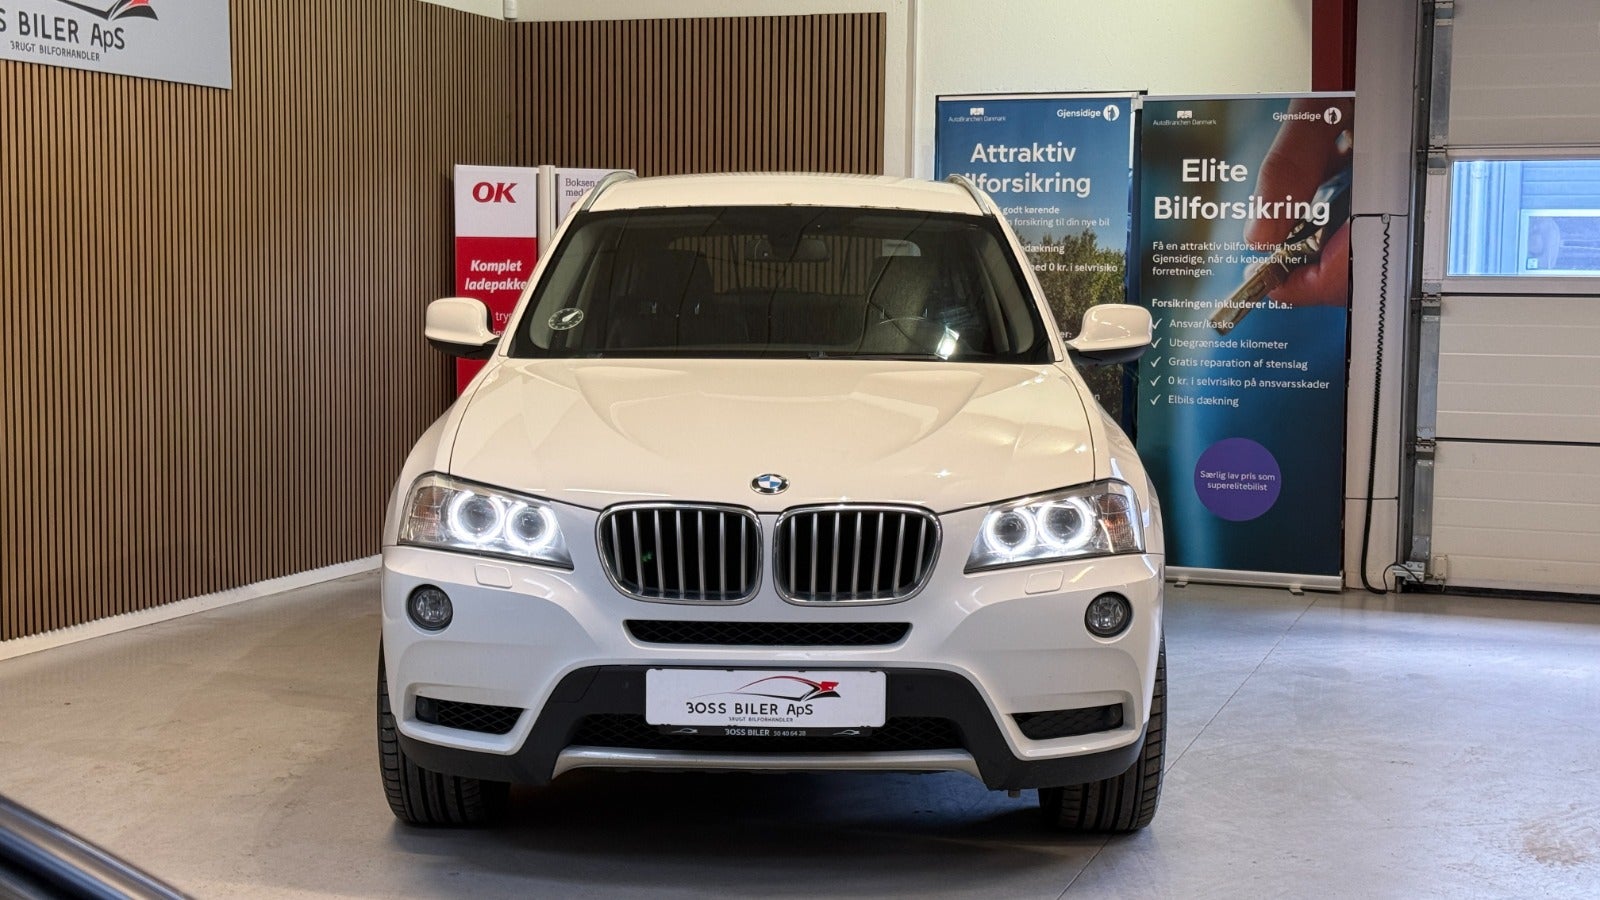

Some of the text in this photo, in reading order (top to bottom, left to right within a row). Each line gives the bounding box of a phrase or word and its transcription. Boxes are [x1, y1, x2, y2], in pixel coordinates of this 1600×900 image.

[18, 11, 79, 43] BILER
[91, 23, 125, 52] ApS
[39, 44, 100, 62] BILFORHANDLER
[1056, 108, 1101, 118] Gjensidige
[1272, 112, 1321, 122] Gjensidige
[970, 141, 1077, 163] Attraktiv
[1182, 157, 1248, 183] Elite
[565, 178, 595, 187] Boksen
[472, 181, 518, 204] OK
[565, 188, 584, 197] med
[1003, 205, 1022, 216] godt
[1024, 205, 1060, 215] kørende
[1154, 195, 1330, 226] Bilforsikring
[1014, 218, 1054, 228] forsikring
[1055, 218, 1065, 226] til
[1066, 218, 1080, 226] din
[1081, 219, 1097, 228] nye
[1098, 218, 1110, 226] bil
[1152, 241, 1302, 253] Få en attraktiv bilforsikring hos
[1152, 254, 1205, 265] Gjensidige,
[1208, 254, 1223, 263] når
[1225, 254, 1238, 264] du
[1270, 254, 1283, 264] bil
[1285, 254, 1301, 264] her
[470, 259, 522, 275] Komplet
[1048, 263, 1055, 272] 0
[1056, 263, 1068, 272] kr.
[1074, 263, 1118, 272] selvrisiko
[1152, 267, 1215, 278] forretningen.
[1152, 298, 1213, 311] Forsikringen
[1214, 299, 1266, 309] inkluderer
[1169, 319, 1235, 330] Ansvar/kasko
[1169, 338, 1288, 350] Ubegrænsede kilometer
[1168, 357, 1308, 371] Gratis reparation af stenslag
[1168, 377, 1175, 385] 0
[1177, 377, 1188, 386] kr.
[1196, 377, 1242, 387] selvrisiko
[1244, 378, 1257, 389] på
[1258, 379, 1330, 390] ansvarsskader
[1168, 395, 1239, 407] Elbils dækning
[1200, 470, 1276, 481] Særlig lav pris som
[1207, 482, 1268, 491] superelitebilist
[734, 702, 778, 715] BILER
[786, 703, 813, 717] ApS
